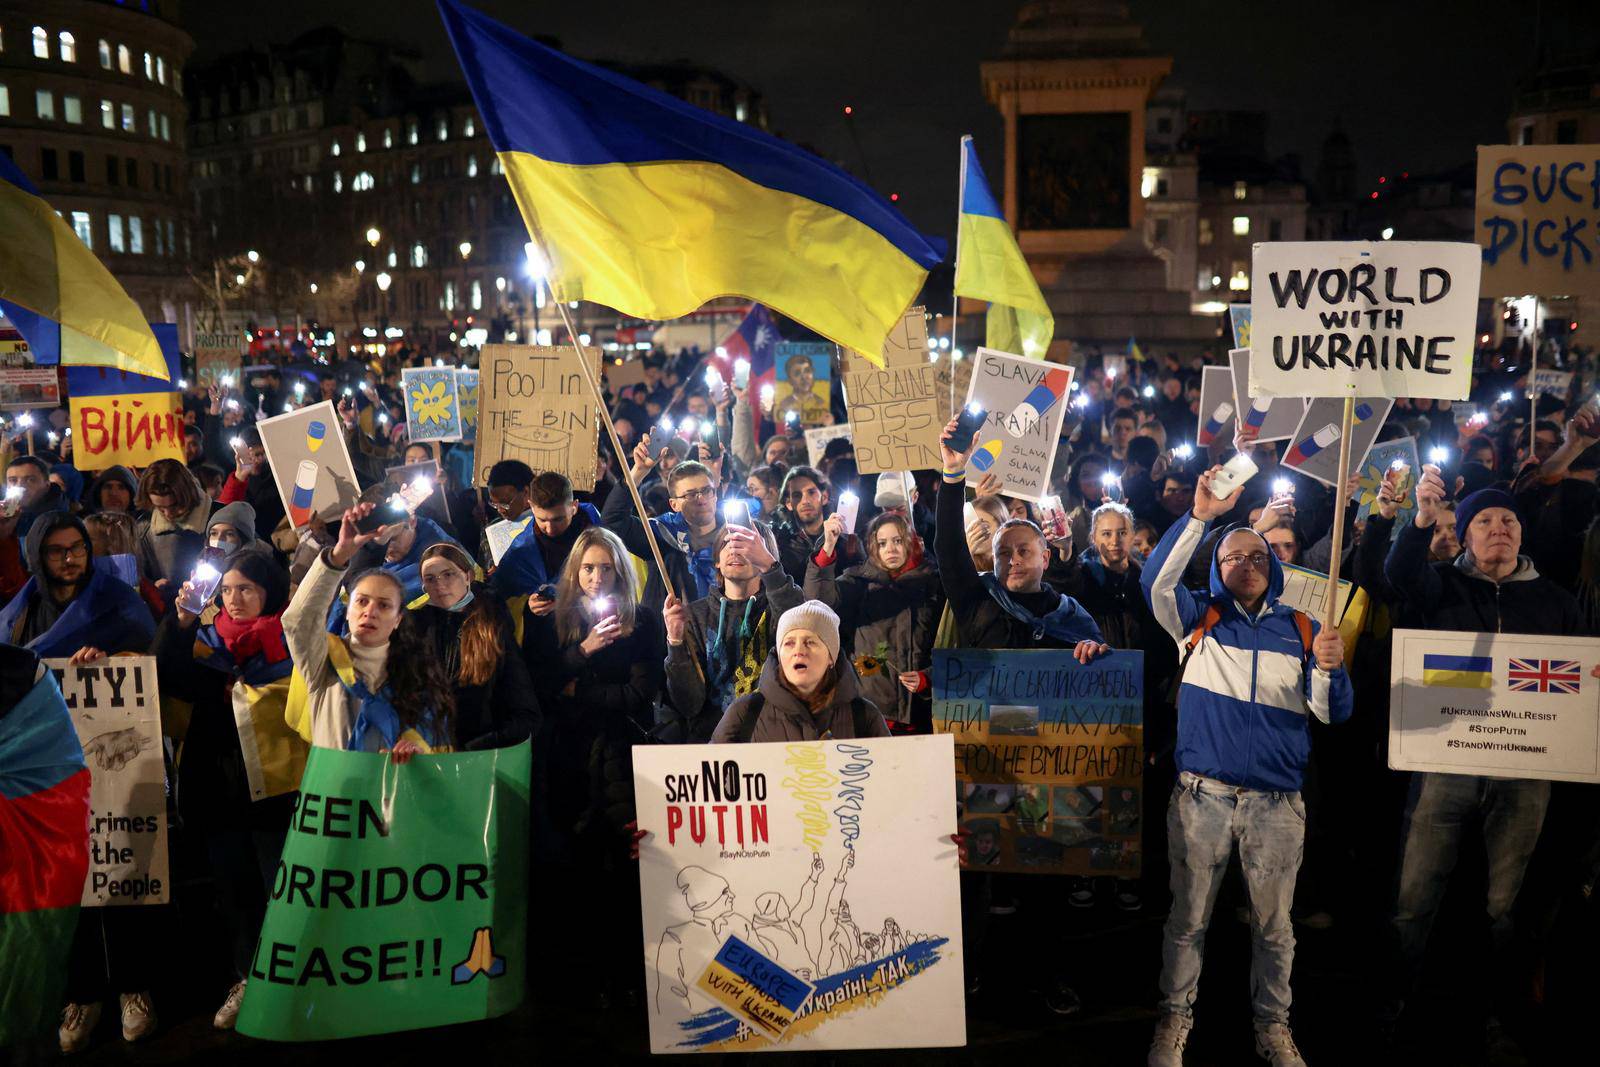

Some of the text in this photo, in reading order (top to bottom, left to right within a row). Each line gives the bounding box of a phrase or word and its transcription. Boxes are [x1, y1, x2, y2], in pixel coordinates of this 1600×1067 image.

[1269, 263, 1451, 309] WORLD
[1319, 310, 1403, 329] WITH
[195, 335, 238, 348] PROTECT
[1273, 333, 1455, 374] UKRAINE
[845, 366, 935, 406] UKRAINE
[985, 357, 1048, 387] SLAVA
[488, 404, 587, 430] THE BIN
[852, 400, 931, 432] PISS
[877, 433, 908, 446] ON
[1014, 445, 1047, 460] SLAVA
[856, 444, 944, 473] PUTIN
[1009, 458, 1041, 474] SLAVA
[1005, 473, 1037, 488] SLAVA
[665, 760, 768, 803] SAY NO TO
[666, 805, 769, 849] PUTIN
[92, 841, 133, 864] the
[92, 871, 161, 899] People
[272, 863, 489, 909] ORRIDOR
[723, 941, 798, 999] EUROPE
[707, 971, 743, 998] WITH
